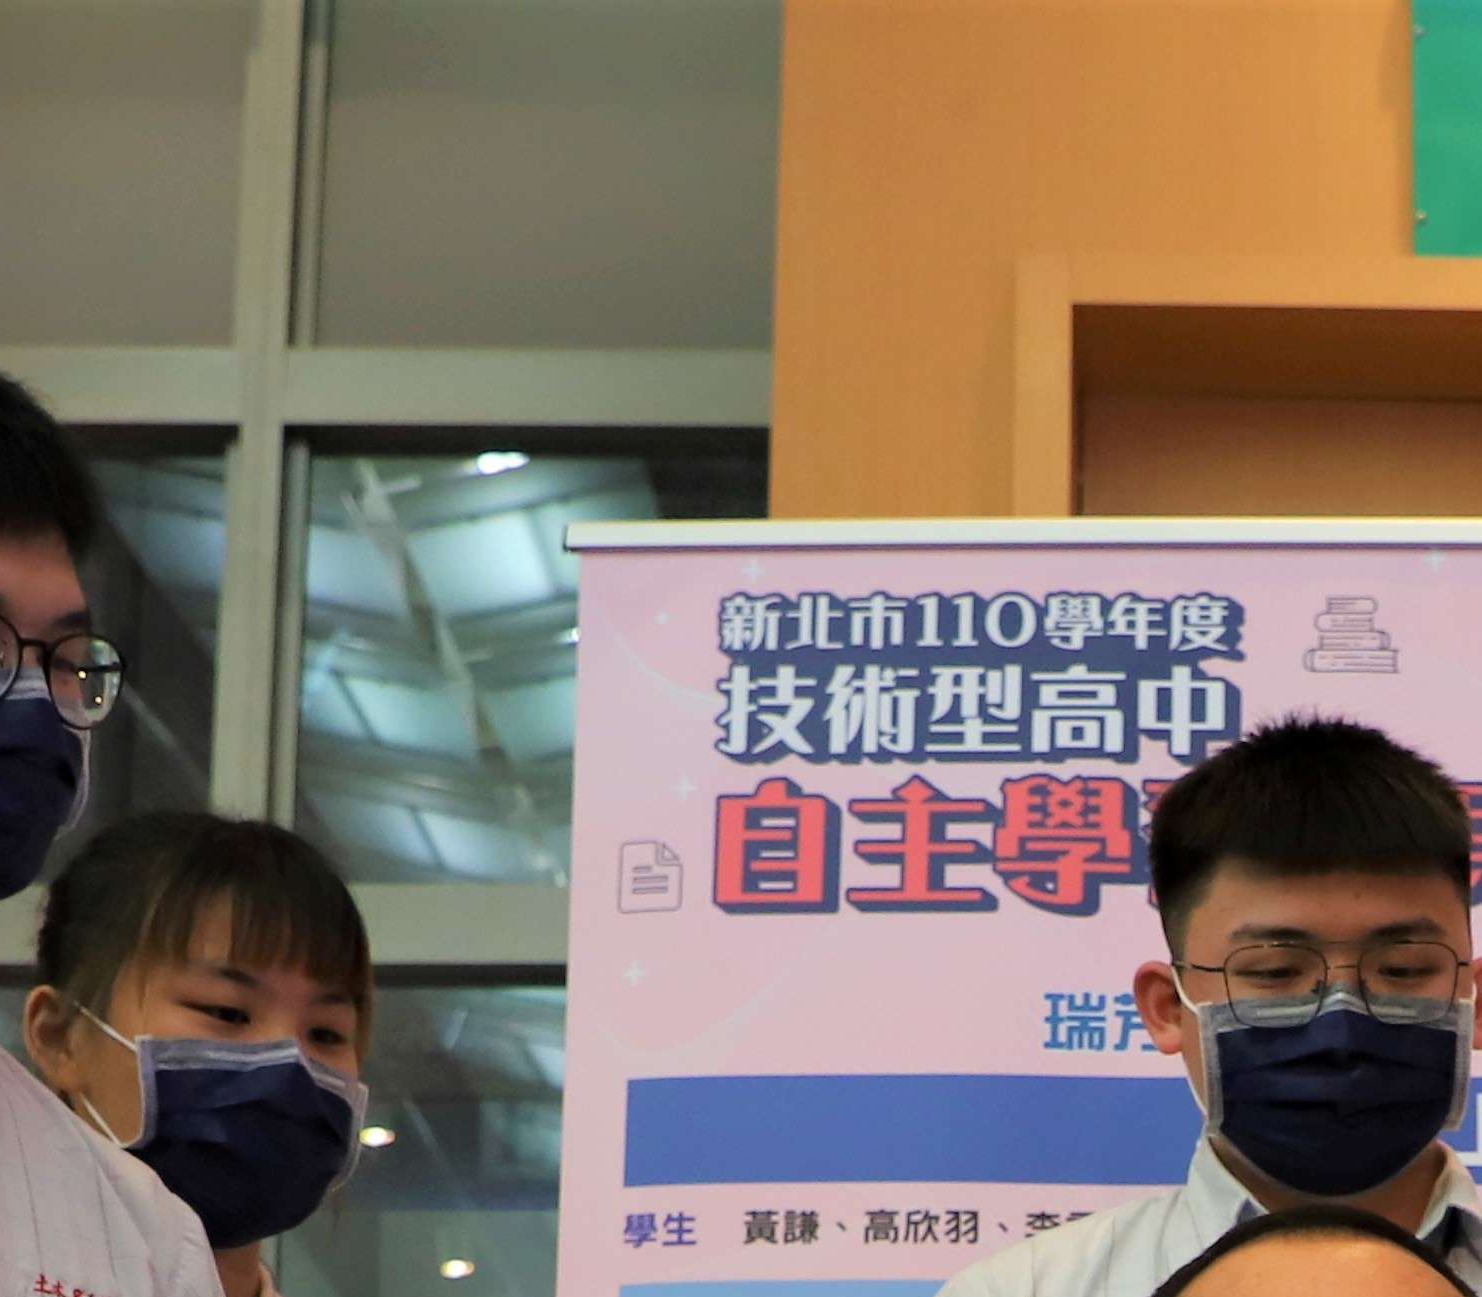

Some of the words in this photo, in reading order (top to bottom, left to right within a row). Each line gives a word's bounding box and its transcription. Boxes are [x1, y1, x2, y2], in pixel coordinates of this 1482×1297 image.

[718, 592, 1236, 656] 新北市110學年度
[716, 662, 1236, 758] 技術型高中
[623, 1212, 698, 1248] 學生
